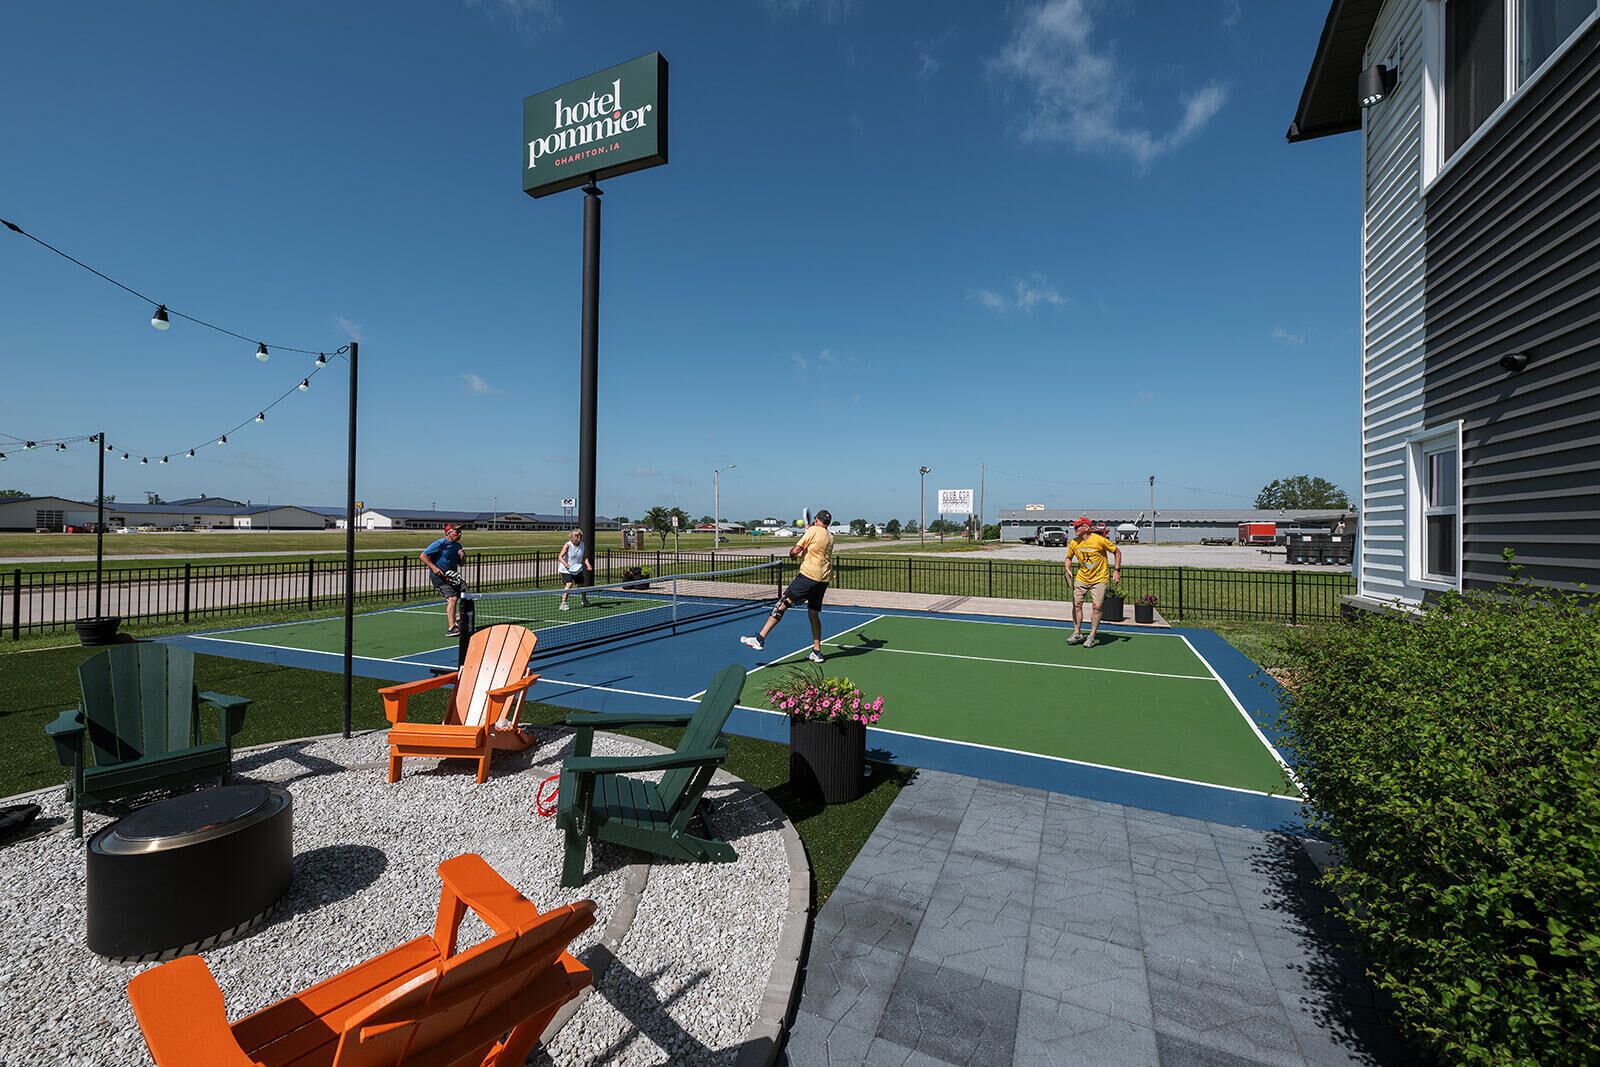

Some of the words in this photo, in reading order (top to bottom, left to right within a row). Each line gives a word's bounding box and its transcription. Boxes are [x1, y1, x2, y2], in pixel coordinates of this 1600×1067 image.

[554, 78, 621, 130] hotel
[527, 104, 652, 169] pommier
[609, 142, 620, 151] IA
